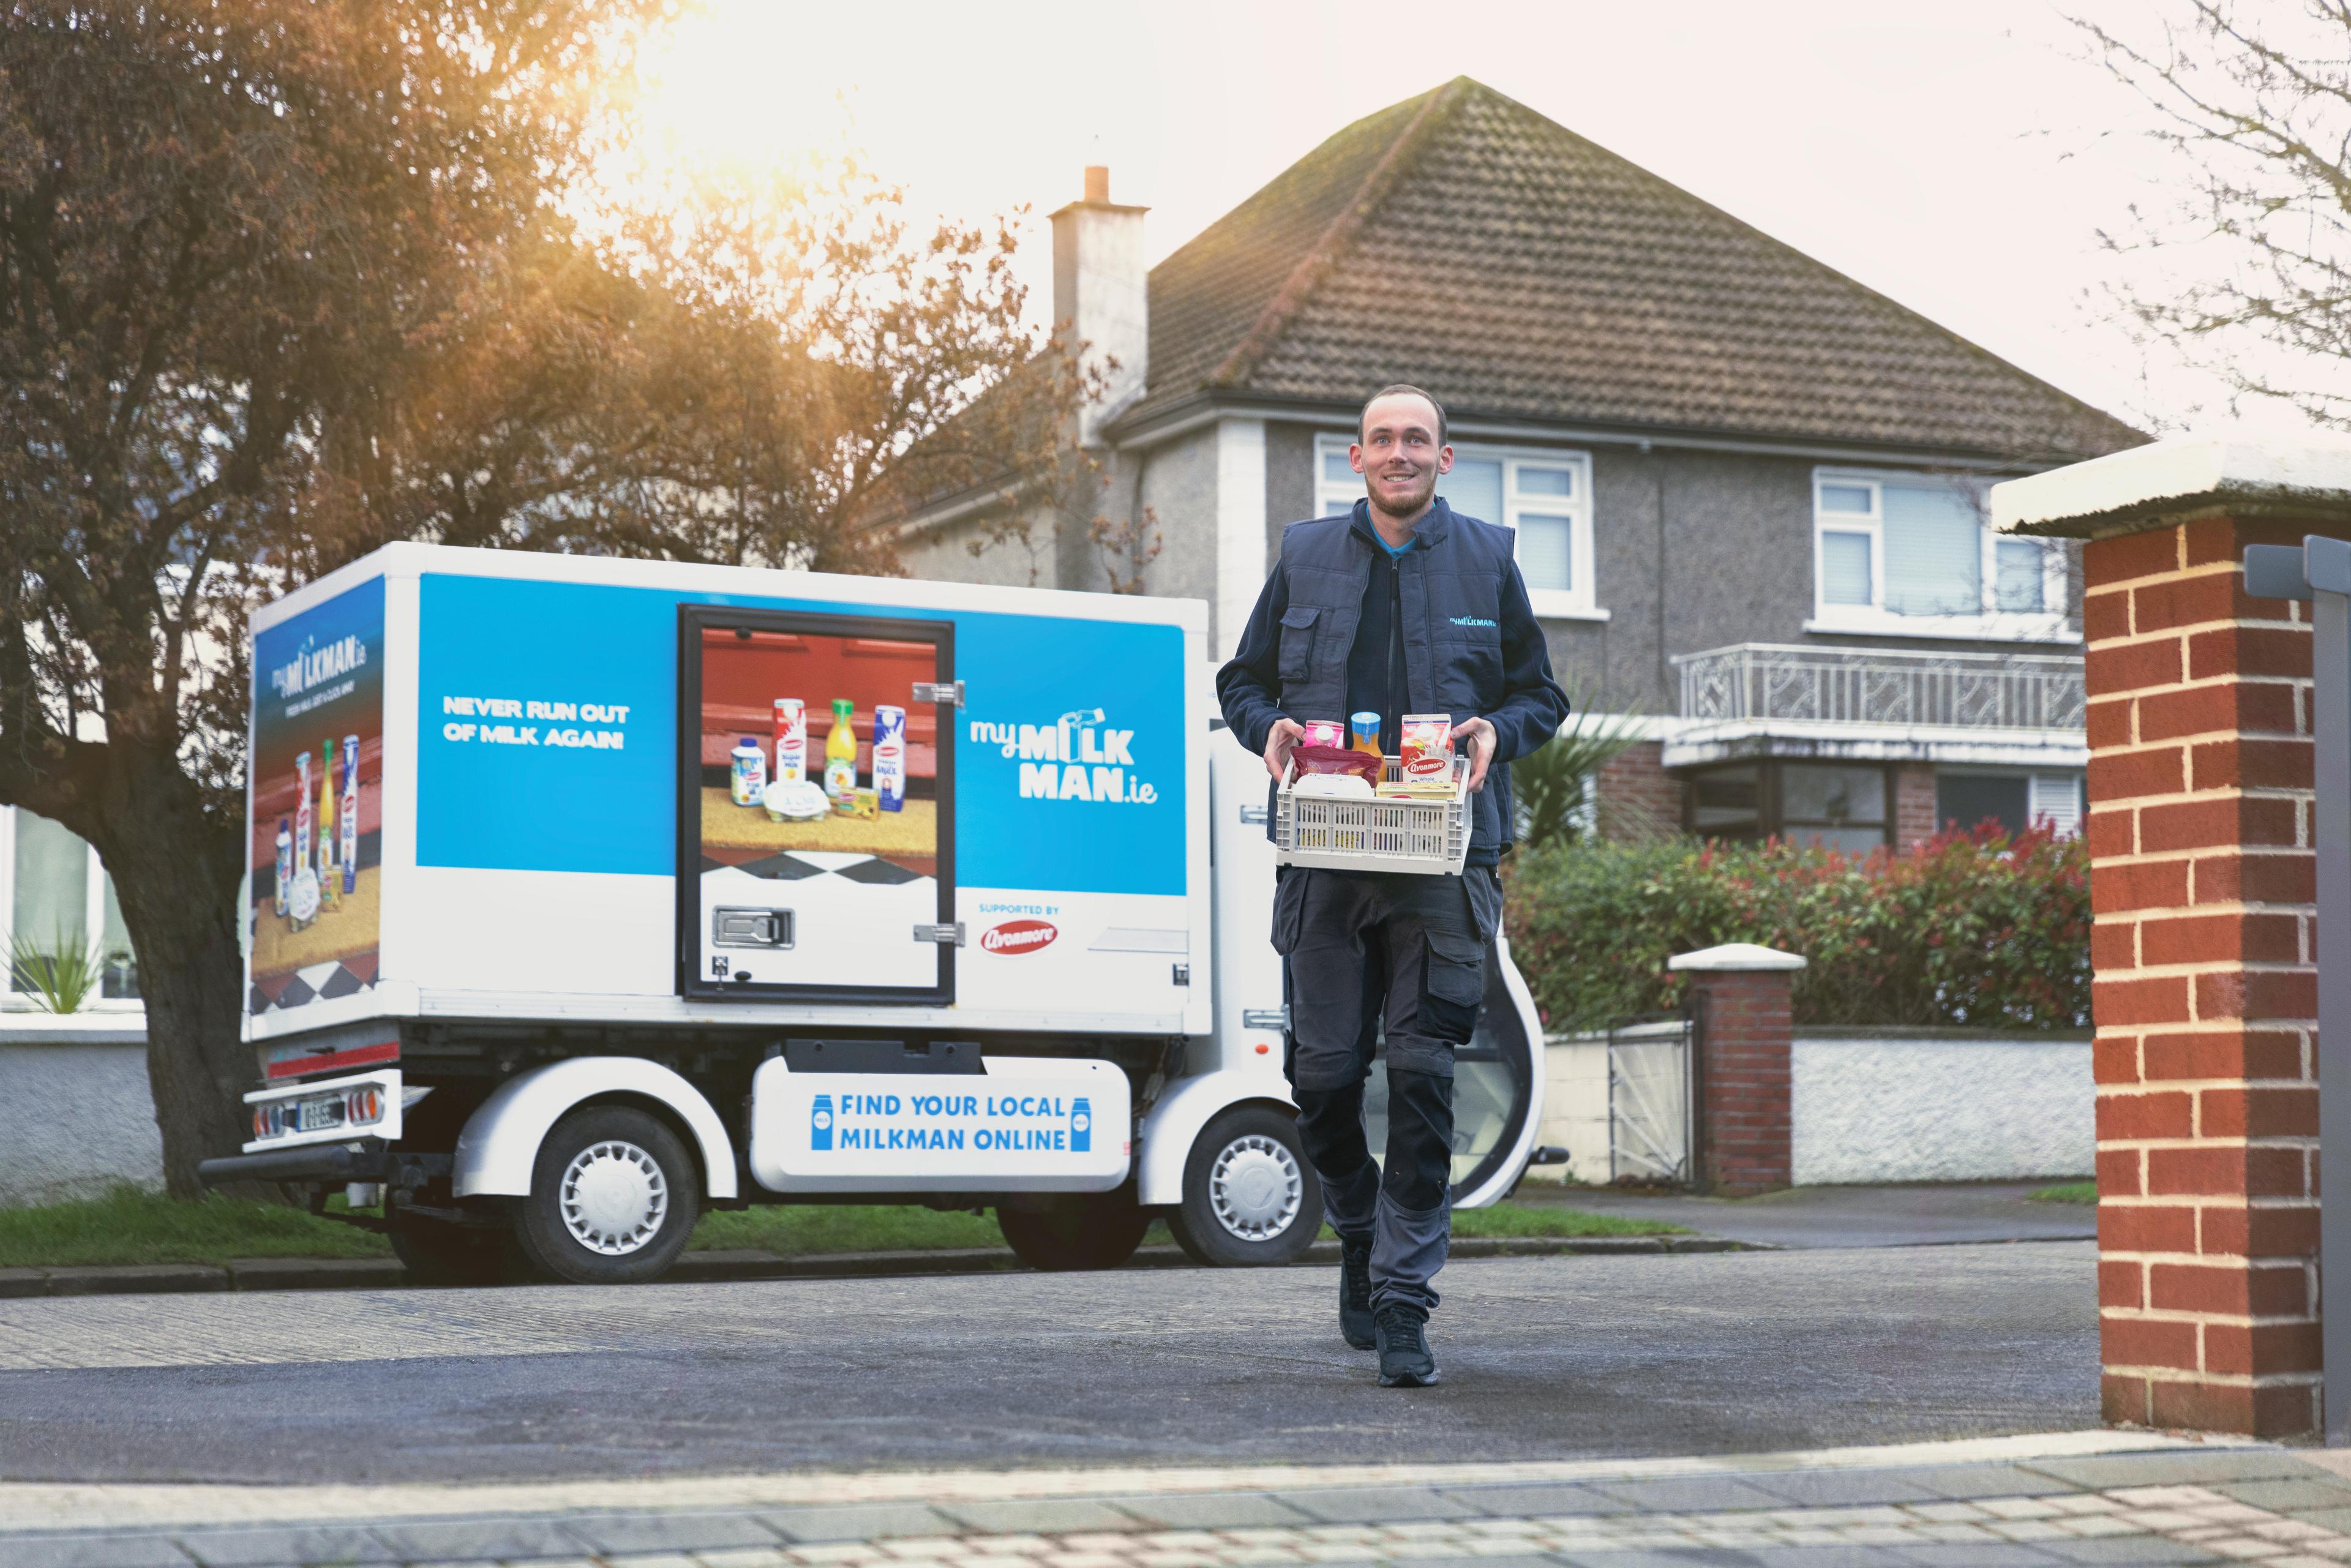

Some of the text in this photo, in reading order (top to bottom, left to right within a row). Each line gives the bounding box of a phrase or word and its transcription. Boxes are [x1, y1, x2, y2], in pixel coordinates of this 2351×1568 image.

[443, 696, 629, 724] NEVER RUN OUT
[443, 722, 624, 750] OF MILK AGAIN!
[1019, 762, 1158, 804] MAN.ie
[979, 904, 1059, 915] SUPPORTED BY
[841, 1095, 1065, 1117] FIND YOUR LOCAL
[840, 1128, 1065, 1150] MILKMAN ONLINE
